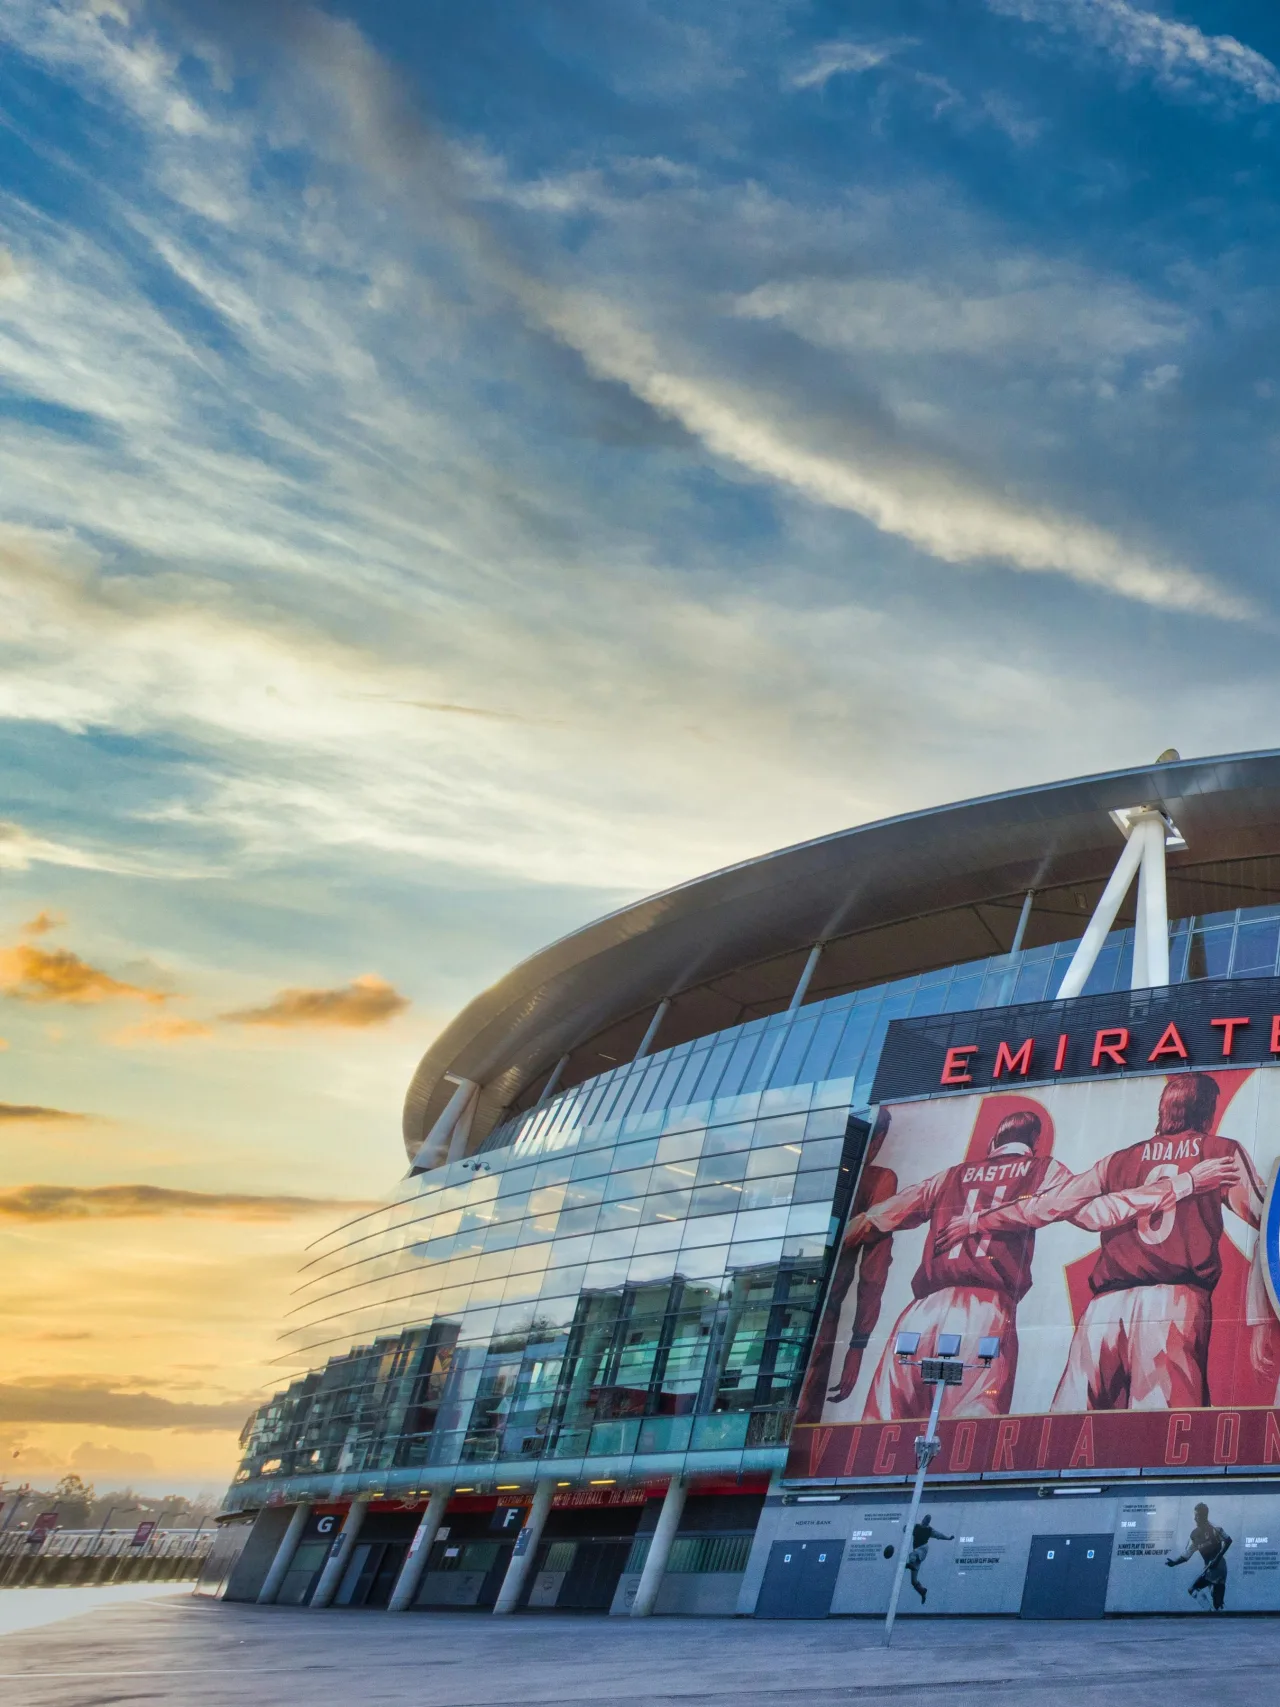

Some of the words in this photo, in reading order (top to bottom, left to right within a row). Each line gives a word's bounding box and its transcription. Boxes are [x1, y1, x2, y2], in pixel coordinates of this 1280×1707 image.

[1141, 1137, 1202, 1161] ADAMS
[963, 1161, 1032, 1183] BASTIN
[809, 1416, 1096, 1477] VICORIA
[317, 1516, 335, 1533] G
[503, 1508, 518, 1527] F
